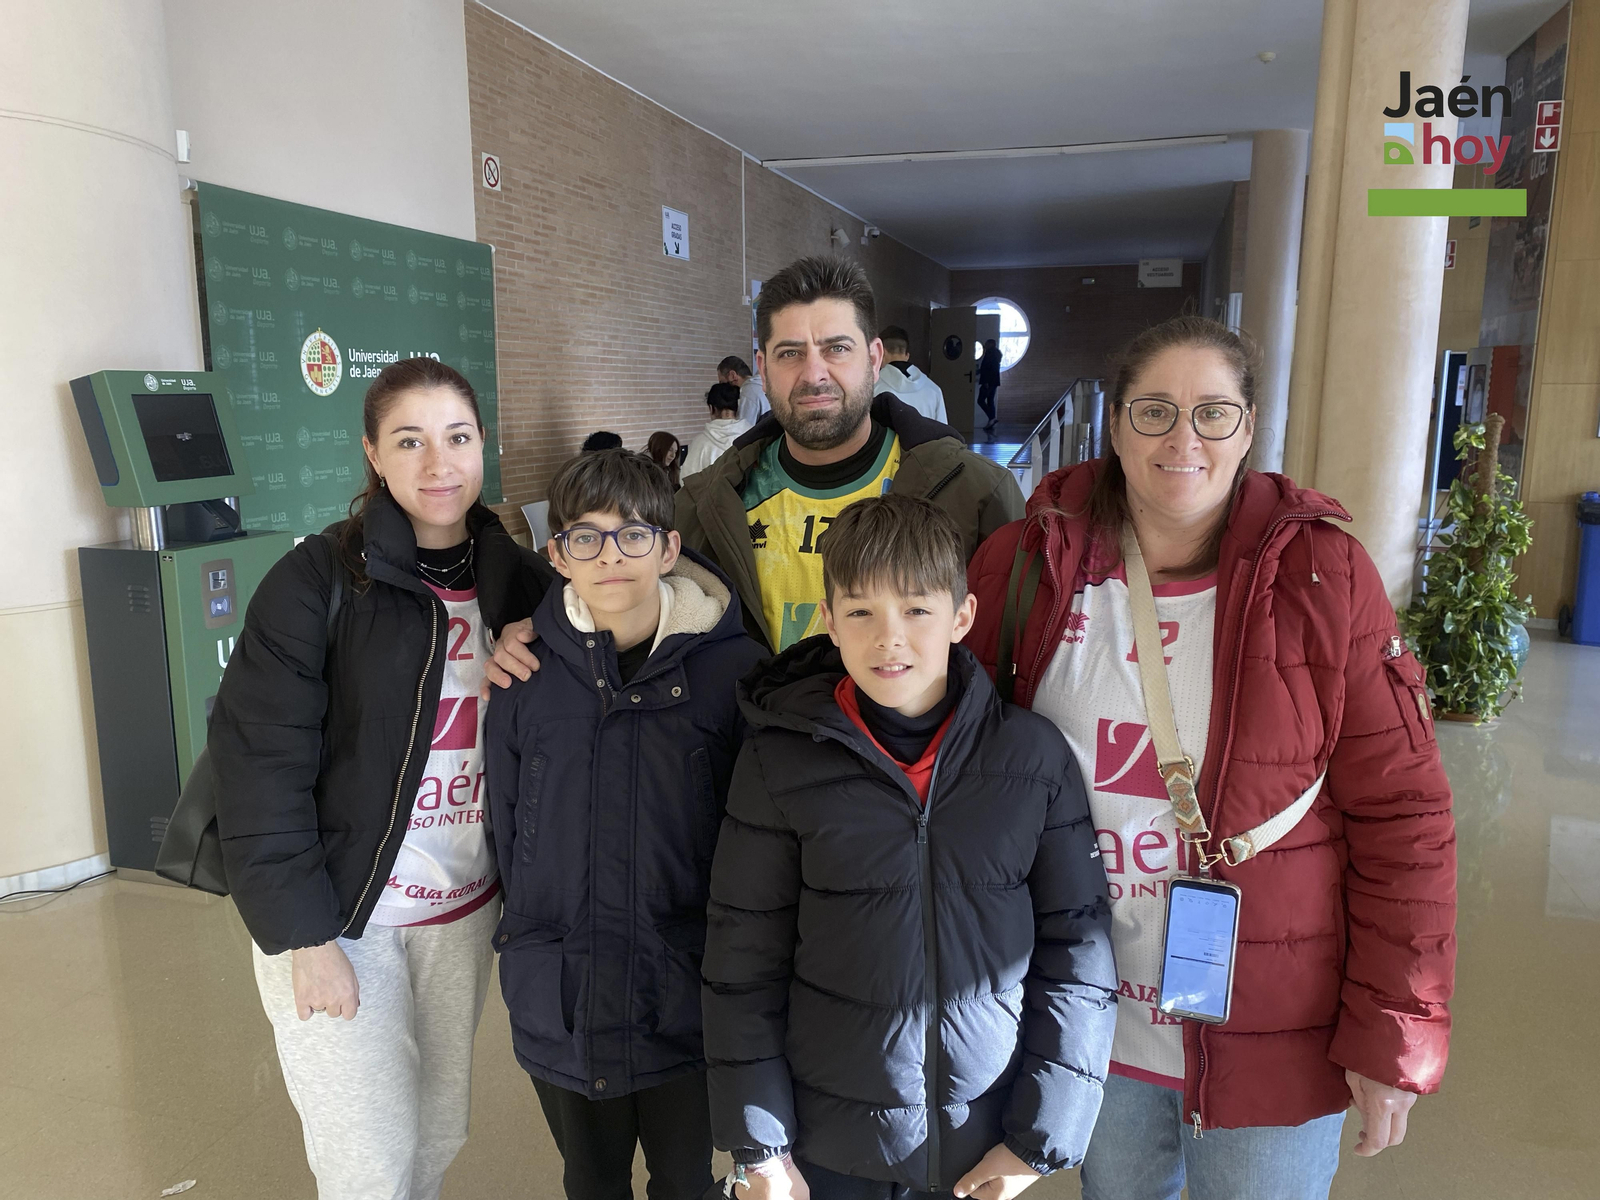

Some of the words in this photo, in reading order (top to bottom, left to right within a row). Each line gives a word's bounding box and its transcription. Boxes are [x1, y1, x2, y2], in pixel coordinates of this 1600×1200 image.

[348, 348, 399, 364] Universidad
[350, 365, 360, 378] de
[448, 617, 474, 661] 2
[438, 810, 485, 827] INTER
